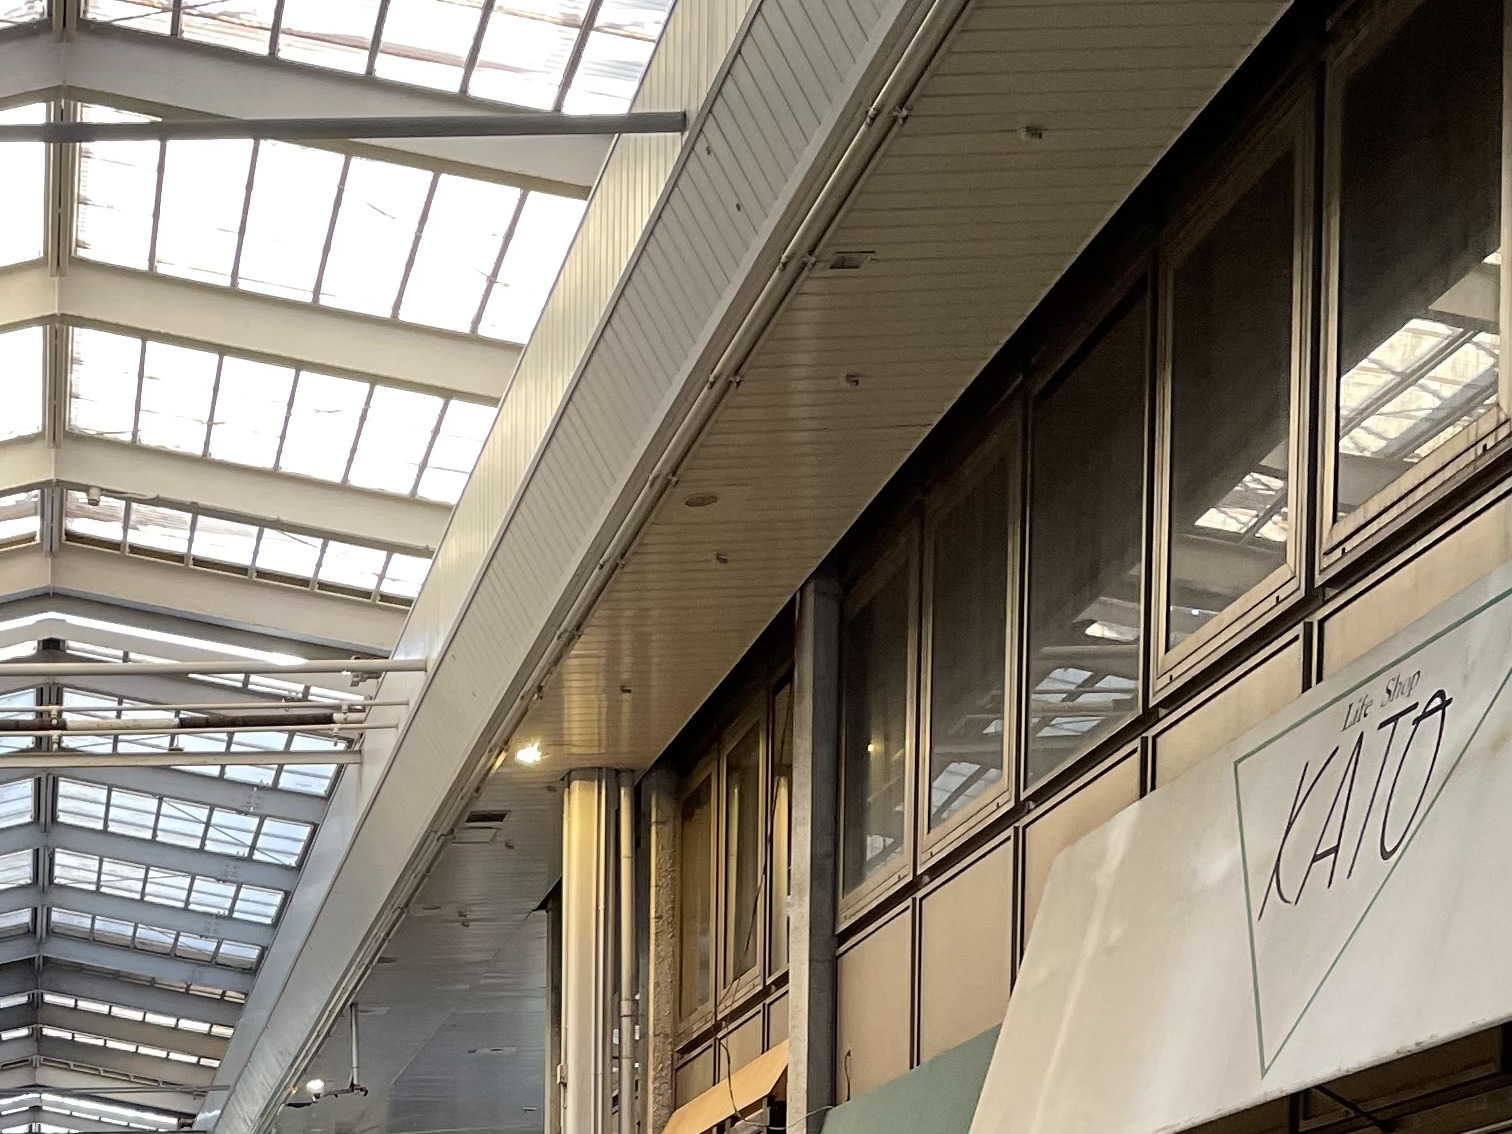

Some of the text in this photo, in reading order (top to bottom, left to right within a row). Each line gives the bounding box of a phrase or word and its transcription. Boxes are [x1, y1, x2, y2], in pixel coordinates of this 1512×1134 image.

[1341, 670, 1421, 732] Life Shop
[1257, 688, 1454, 921] KATO
